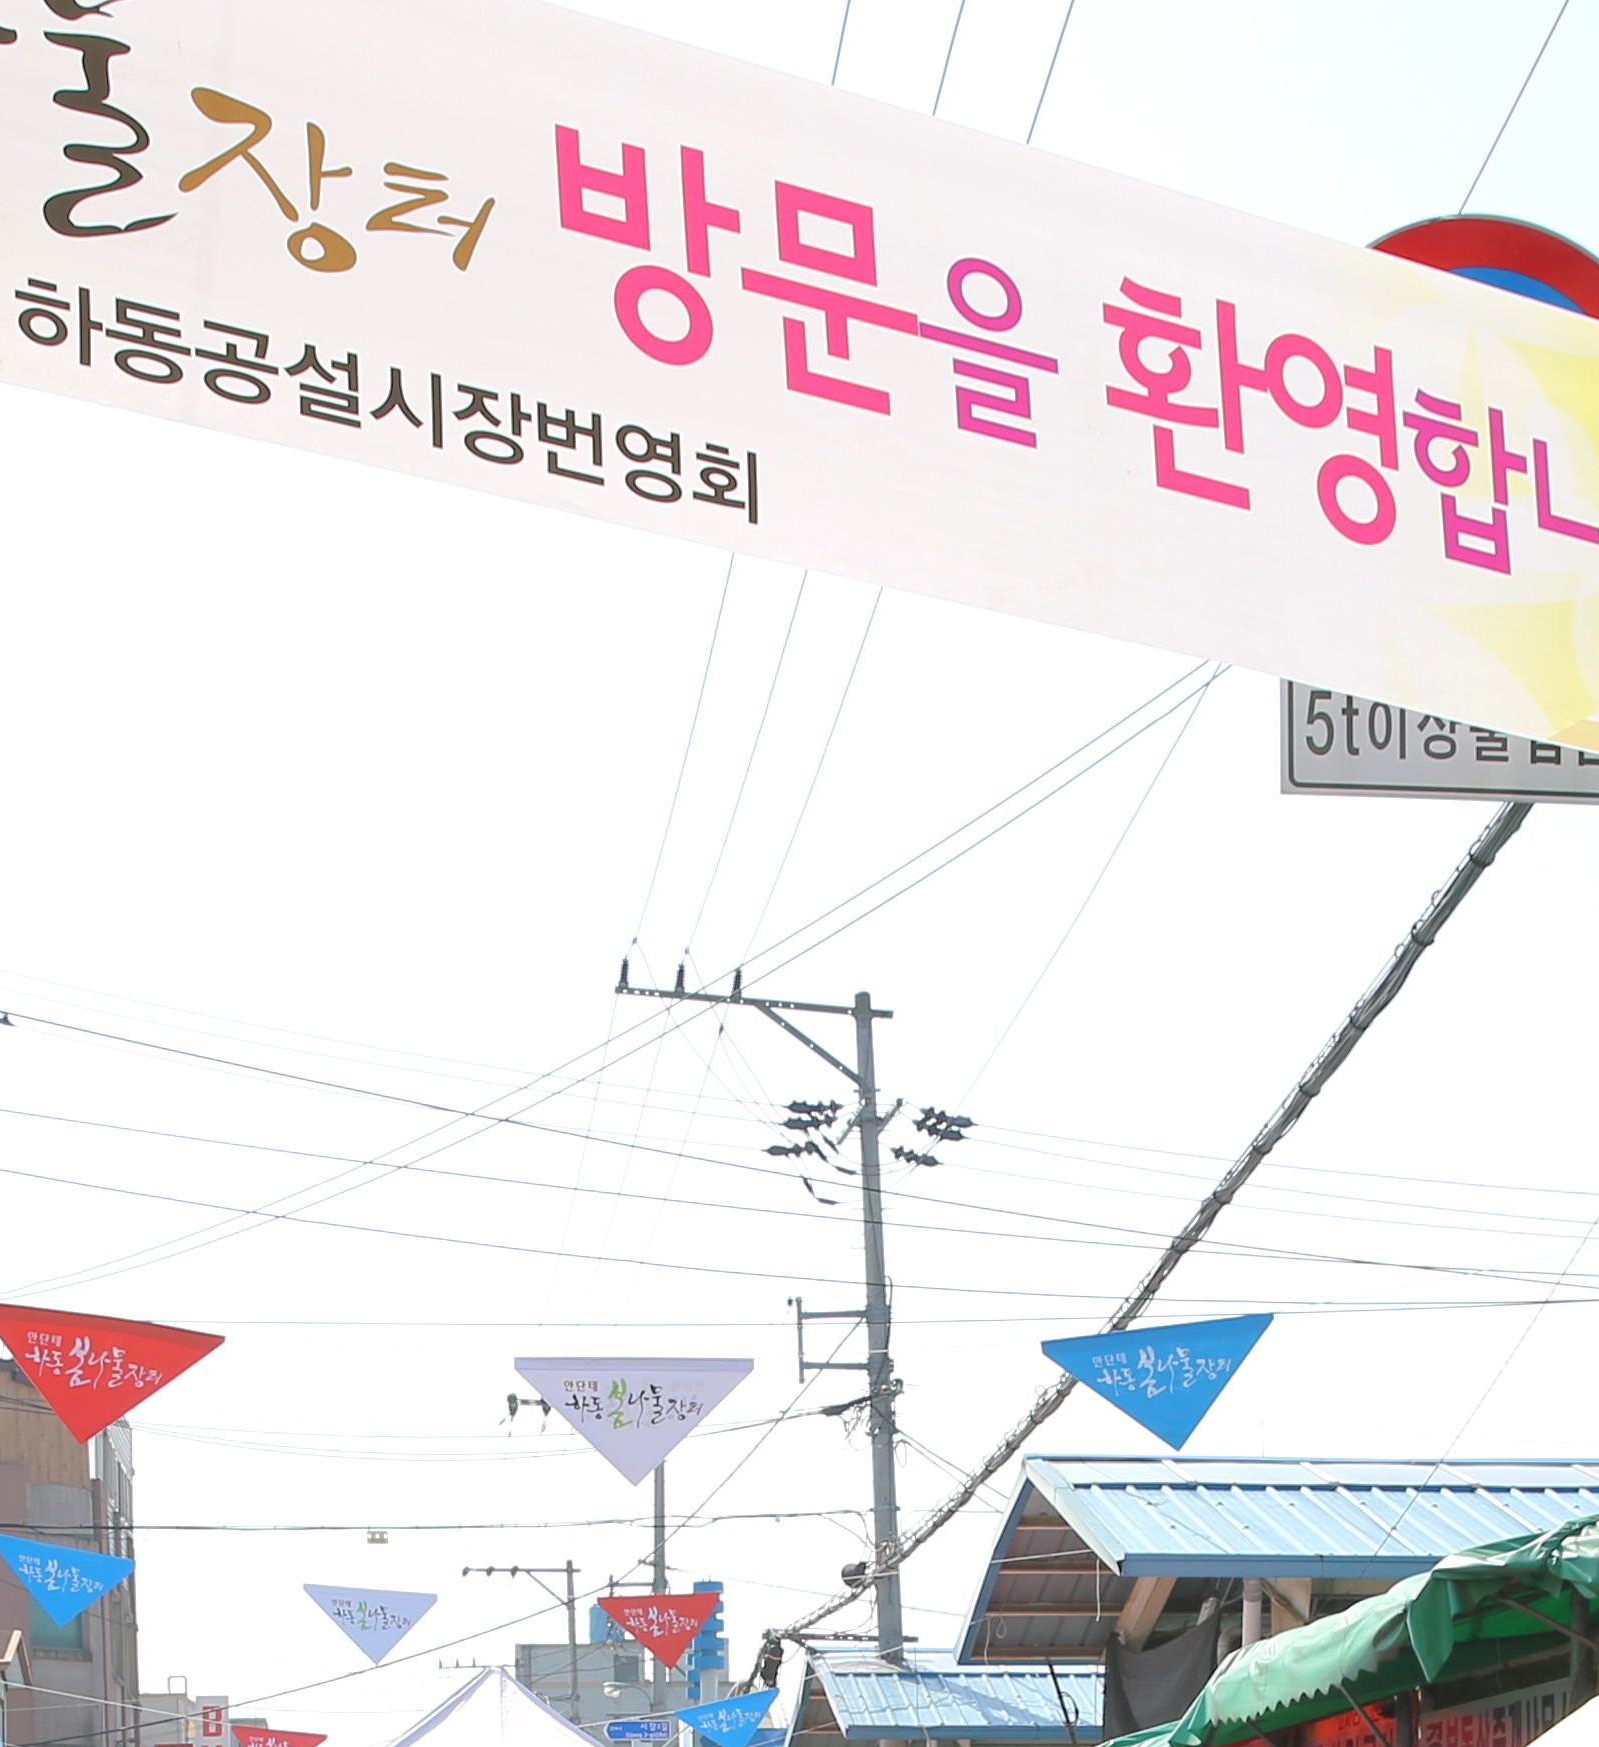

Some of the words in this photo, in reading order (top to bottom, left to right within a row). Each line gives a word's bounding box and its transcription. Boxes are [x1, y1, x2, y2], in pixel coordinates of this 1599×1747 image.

[552, 122, 1060, 454] 방문을
[14, 276, 761, 525] 하동공설시장번영회
[25, 1345, 65, 1377] 하동
[563, 1379, 599, 1393] 안단테
[1096, 1367, 1137, 1397] 하동
[565, 1394, 604, 1424] 하동
